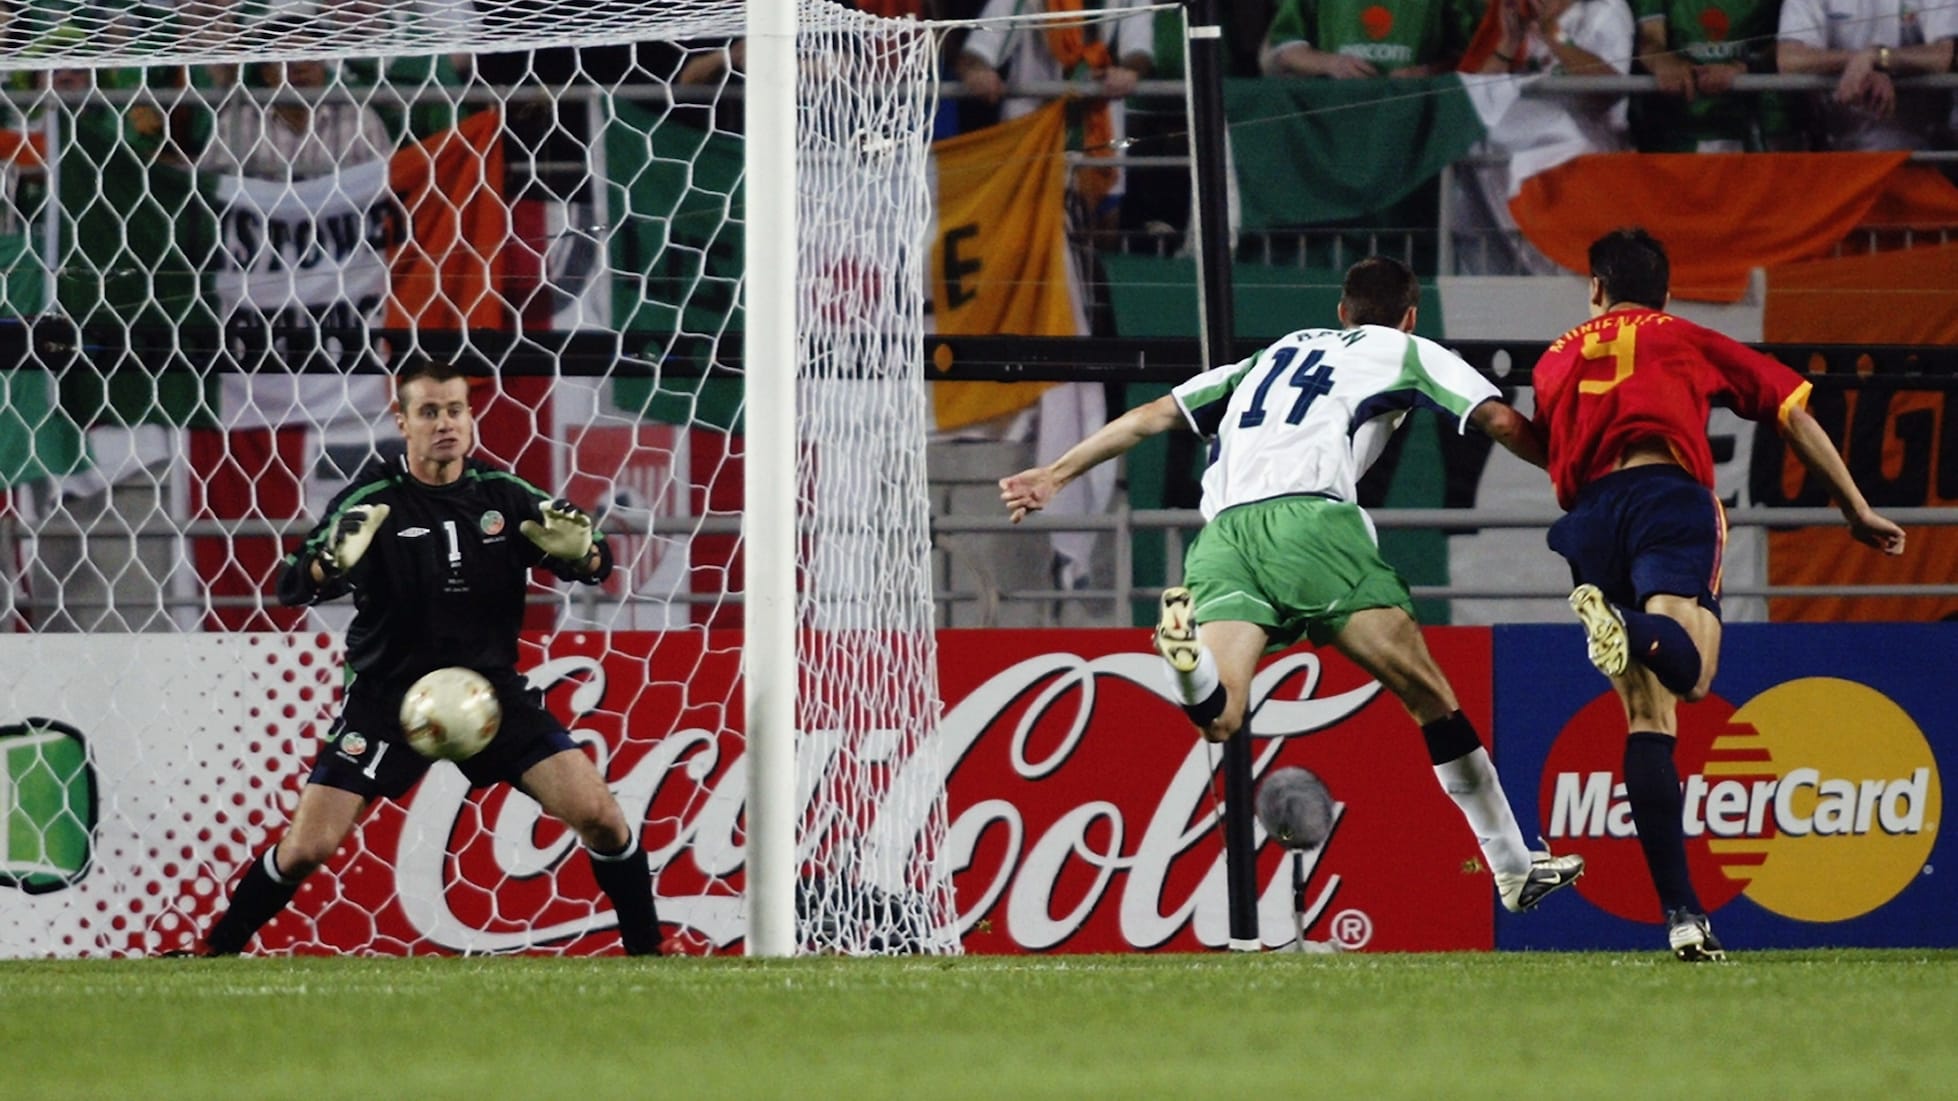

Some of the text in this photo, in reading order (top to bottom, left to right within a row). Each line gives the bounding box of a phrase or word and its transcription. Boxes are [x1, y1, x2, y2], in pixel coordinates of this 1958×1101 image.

[1578, 321, 1638, 386] 9
[1237, 346, 1336, 428] 14
[442, 520, 462, 562] 1
[362, 740, 390, 780] 1
[1548, 766, 1930, 838] MaterCard
